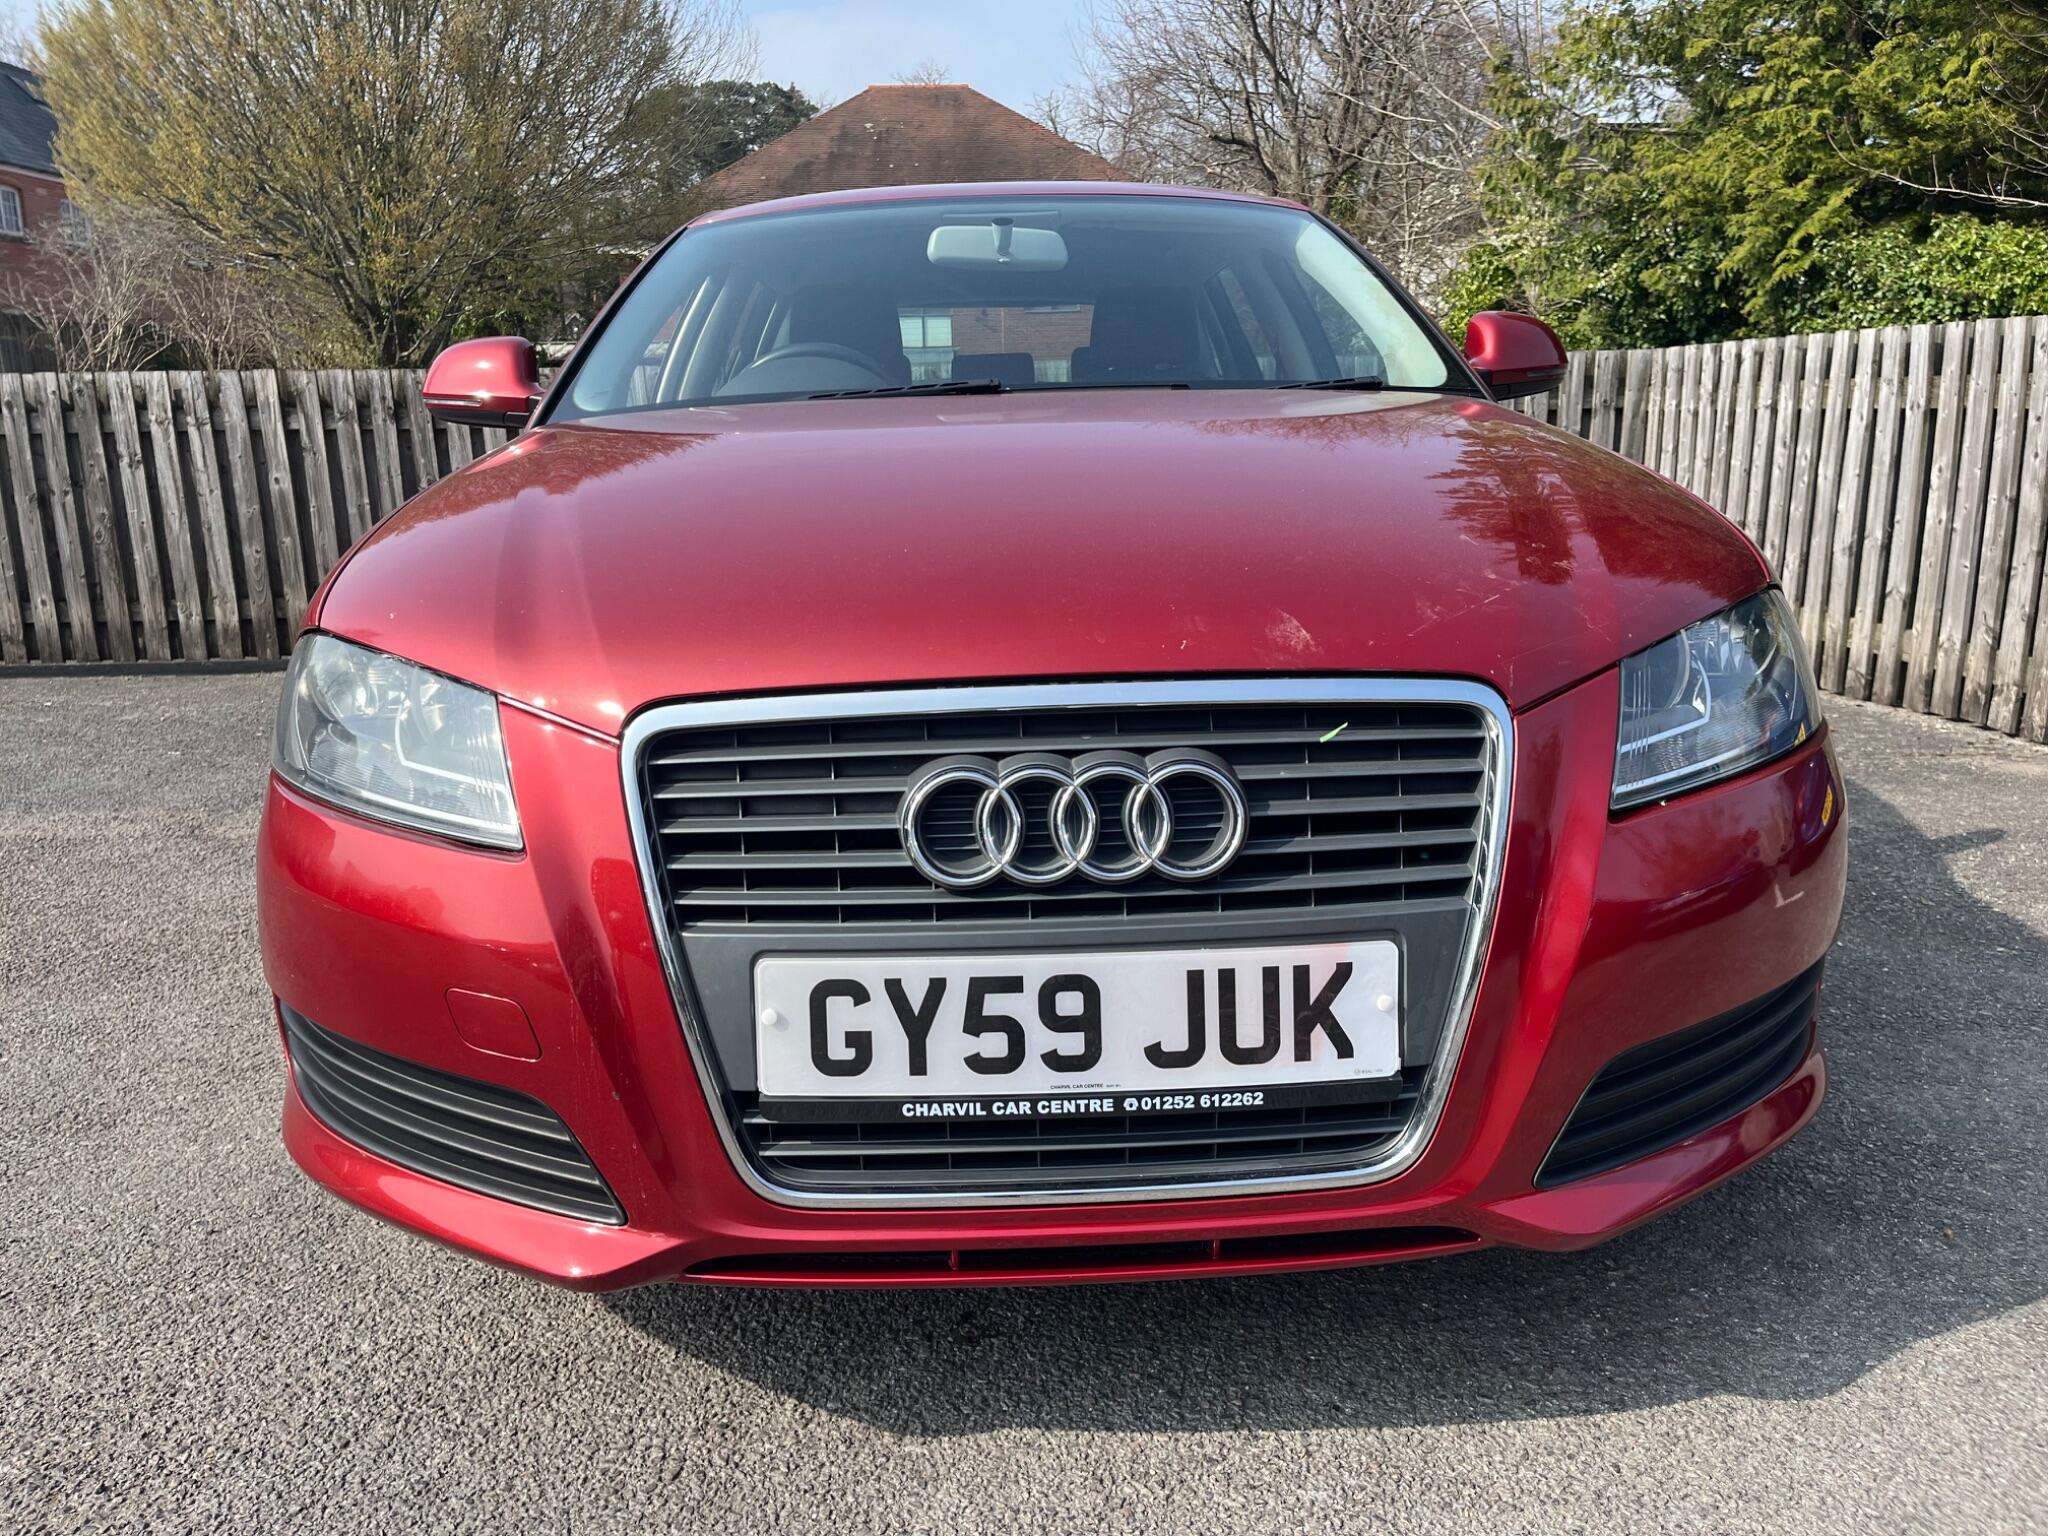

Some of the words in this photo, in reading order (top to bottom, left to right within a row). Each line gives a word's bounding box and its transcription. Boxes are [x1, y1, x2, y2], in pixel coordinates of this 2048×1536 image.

[809, 973, 1102, 1078] GY59
[1144, 961, 1354, 1069] JUK
[902, 1102, 986, 1116] CHARVIL
[992, 1101, 1032, 1114] CAR
[1037, 1099, 1114, 1113] CENTRE
[1141, 1096, 1194, 1110] 01252
[1200, 1092, 1264, 1107] 612262
